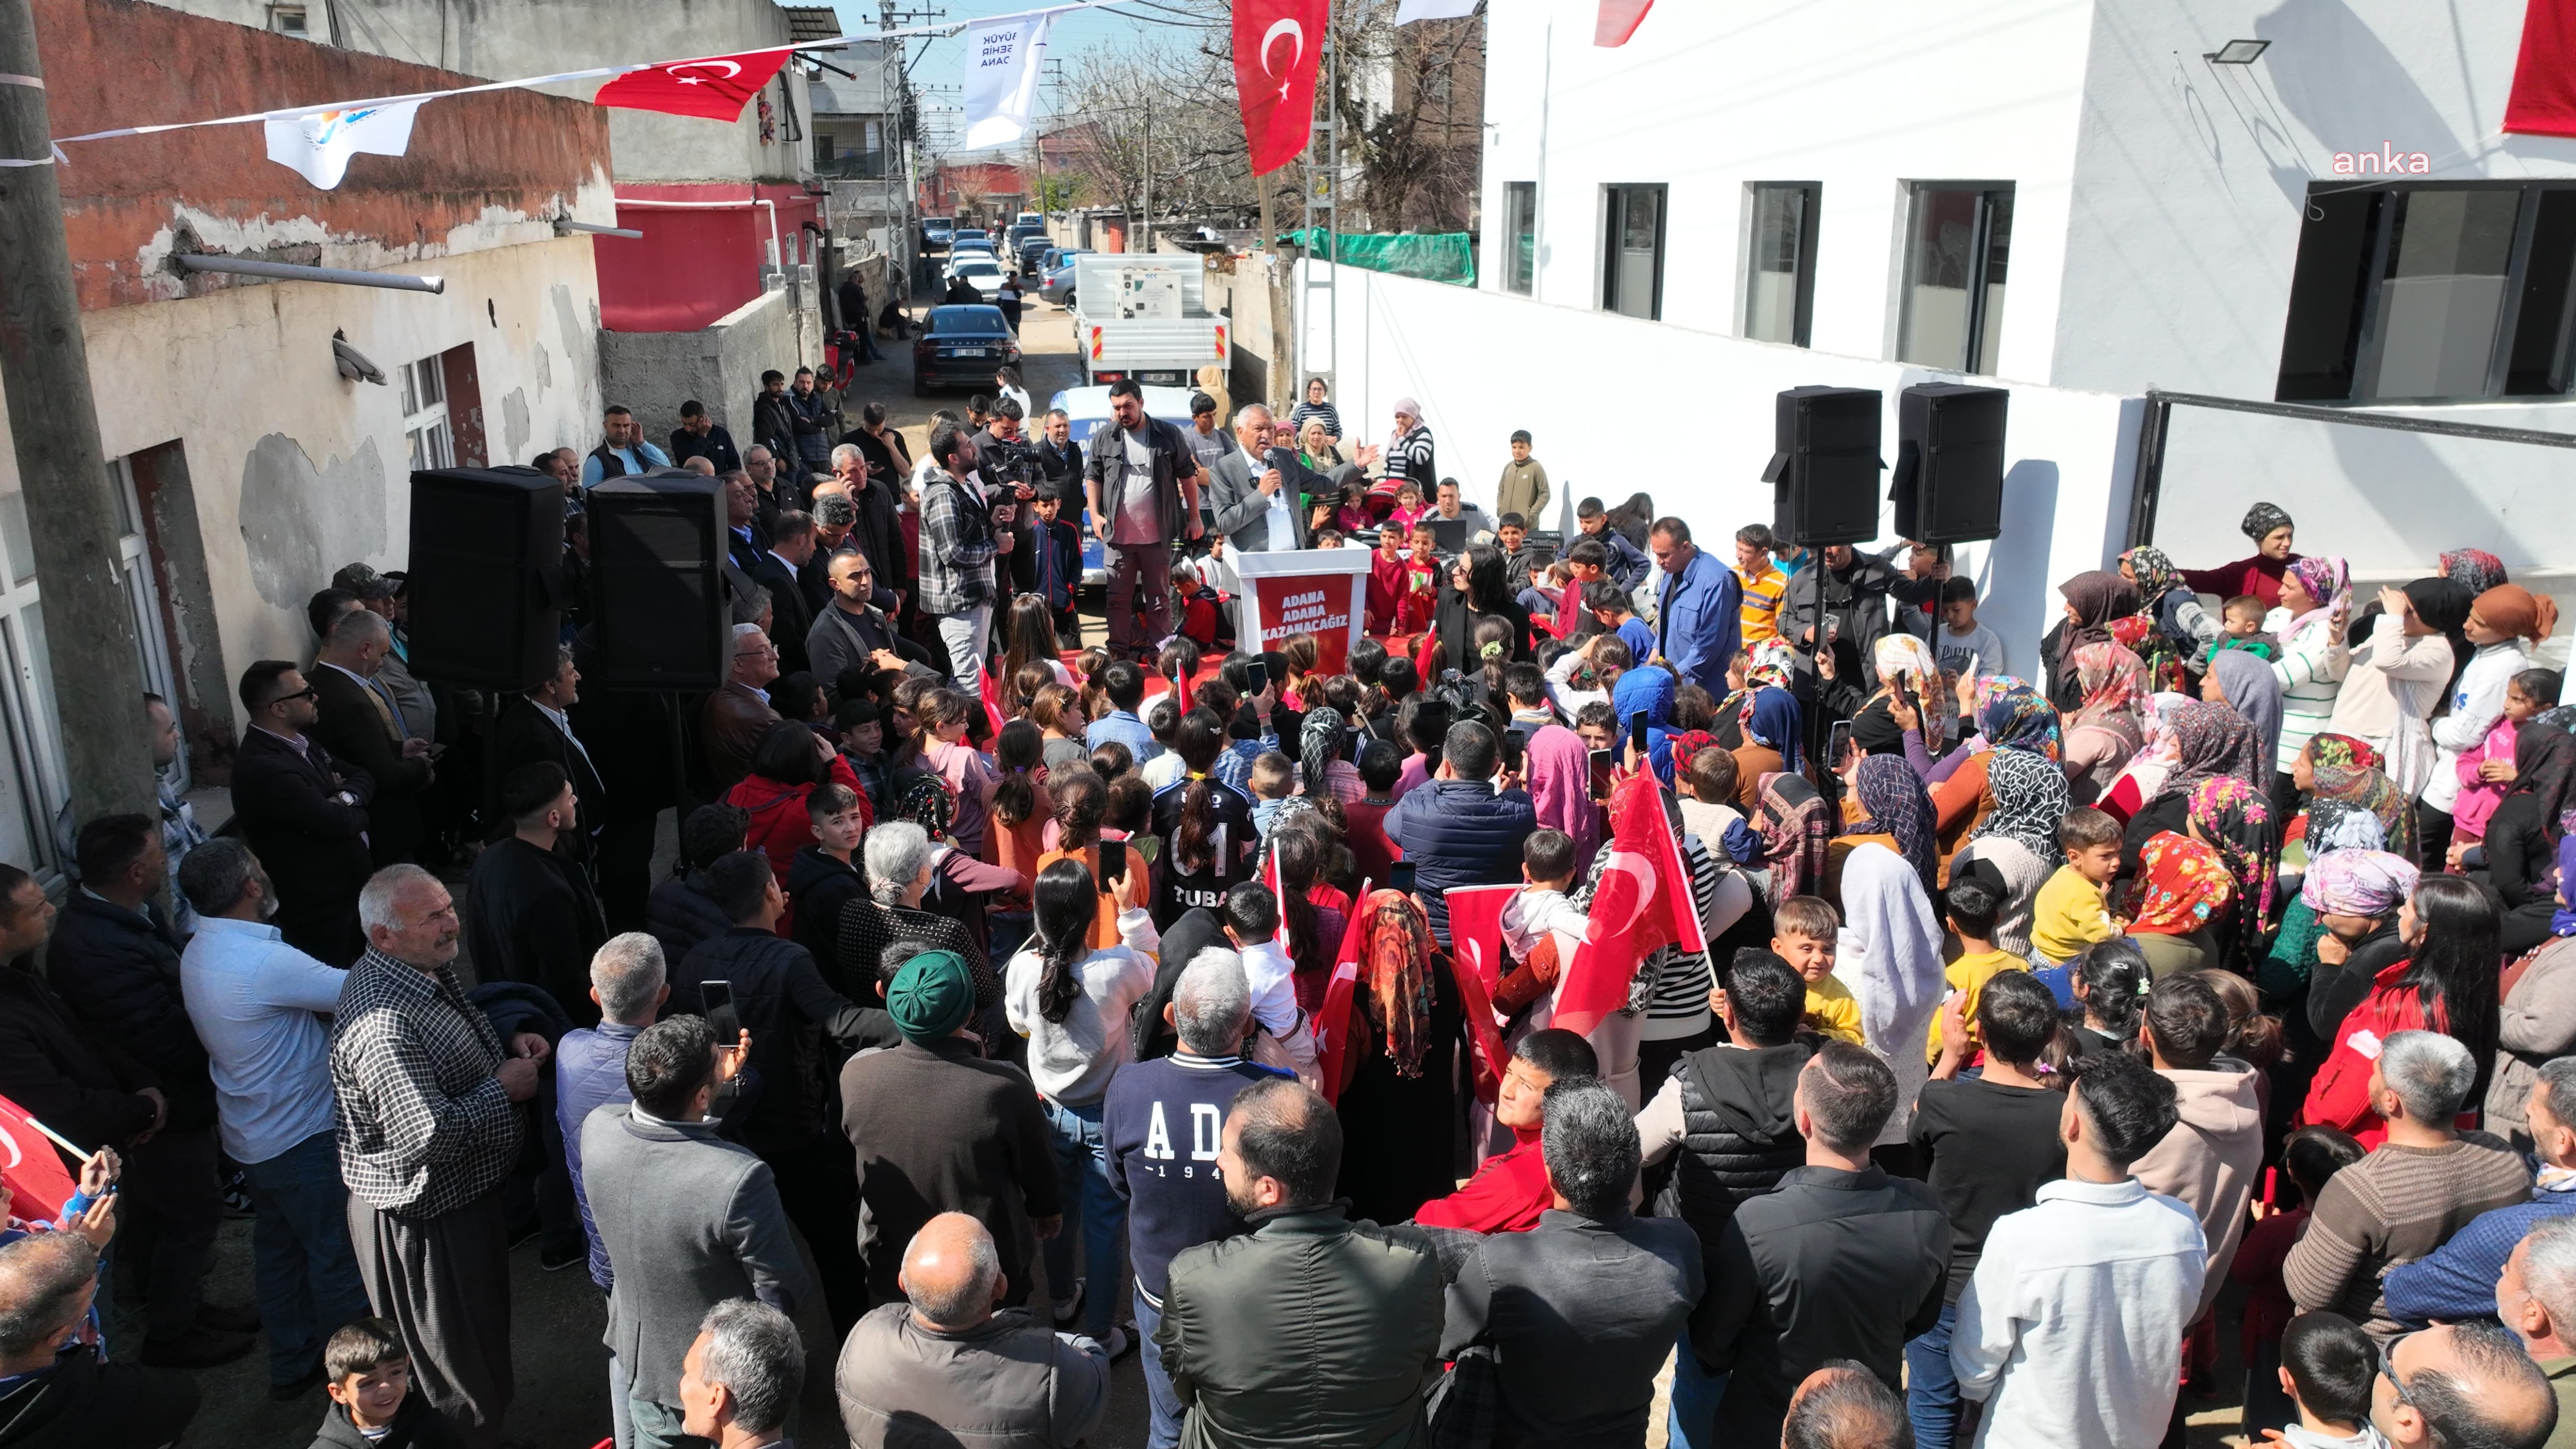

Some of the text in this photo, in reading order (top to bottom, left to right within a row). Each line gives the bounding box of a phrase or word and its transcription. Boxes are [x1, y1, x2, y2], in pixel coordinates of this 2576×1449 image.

[1282, 590, 1326, 609] ADANA
[1282, 604, 1326, 623] ADANA
[1261, 614, 1348, 641] KAZANACAĞIZ
